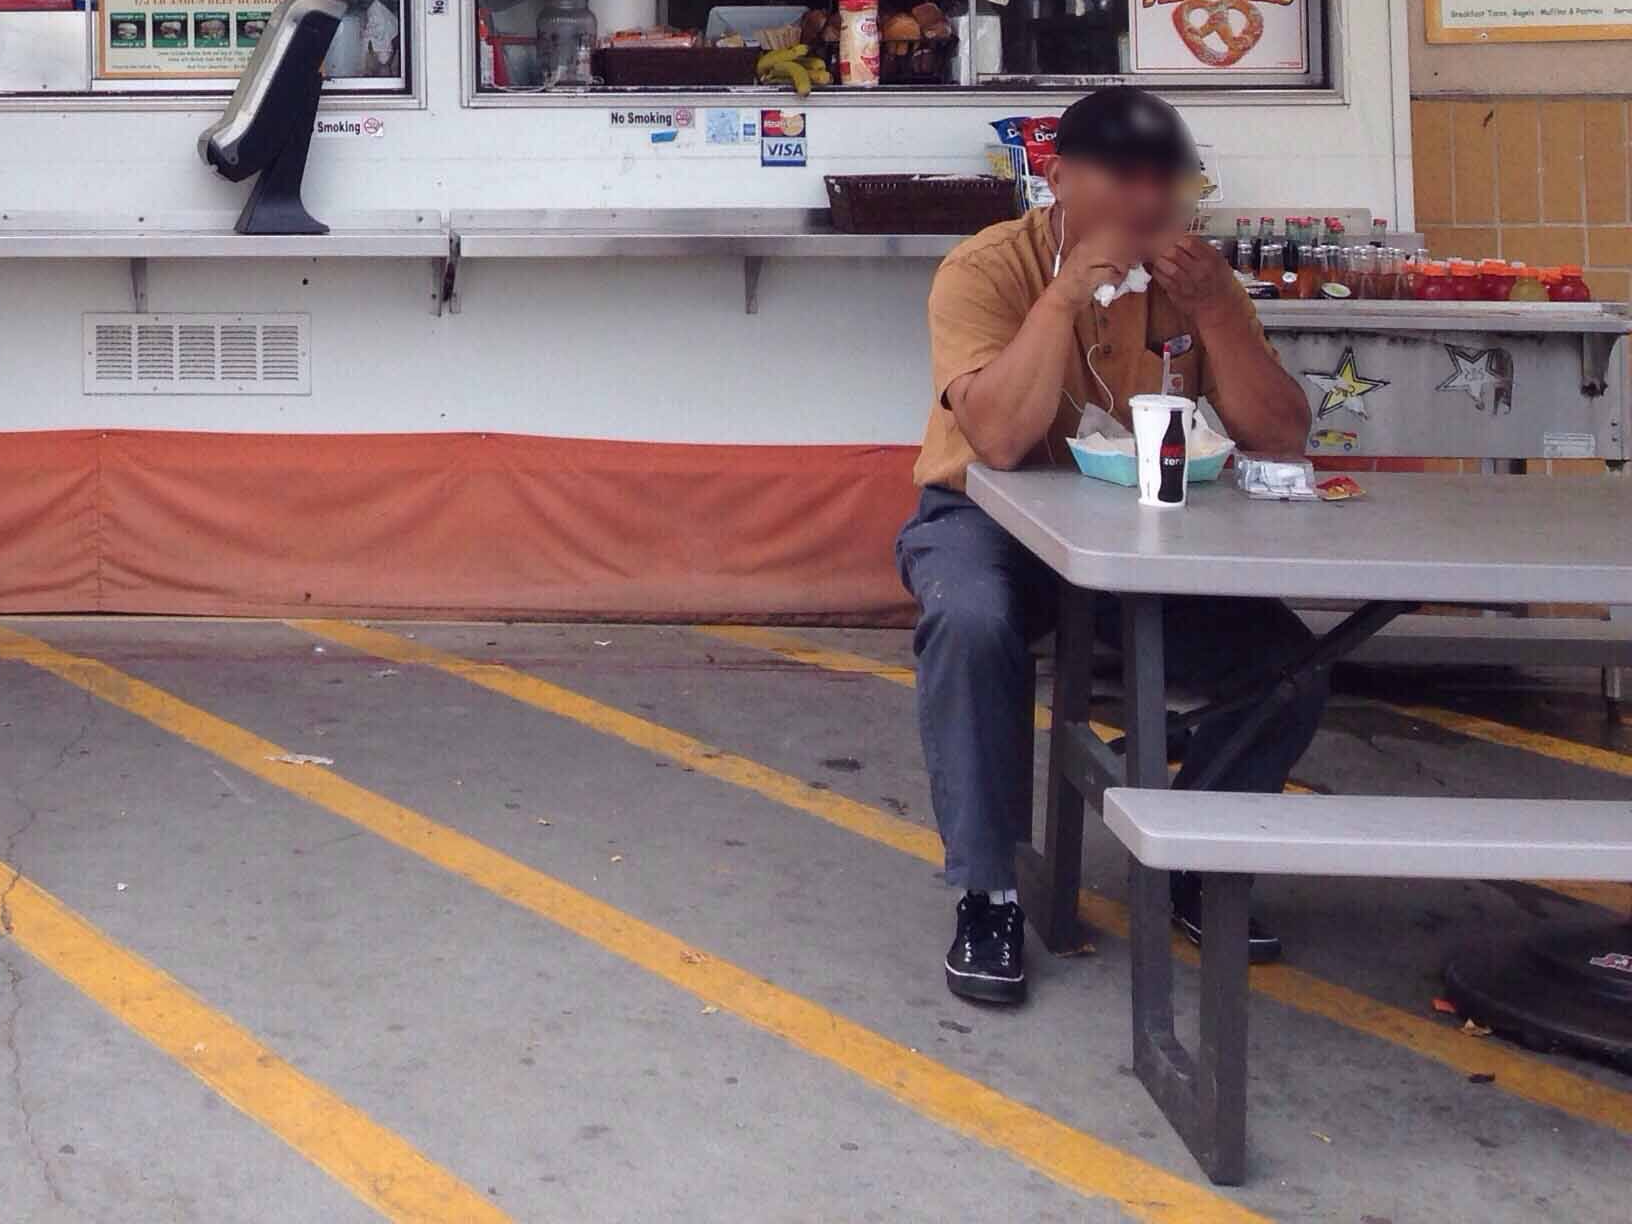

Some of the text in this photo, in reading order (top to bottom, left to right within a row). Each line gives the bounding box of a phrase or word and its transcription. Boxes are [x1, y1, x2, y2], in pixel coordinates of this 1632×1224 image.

[432, 0, 445, 16] No
[610, 111, 673, 128] No Smoking
[317, 120, 362, 136] Smoking
[767, 142, 805, 158] VISA
